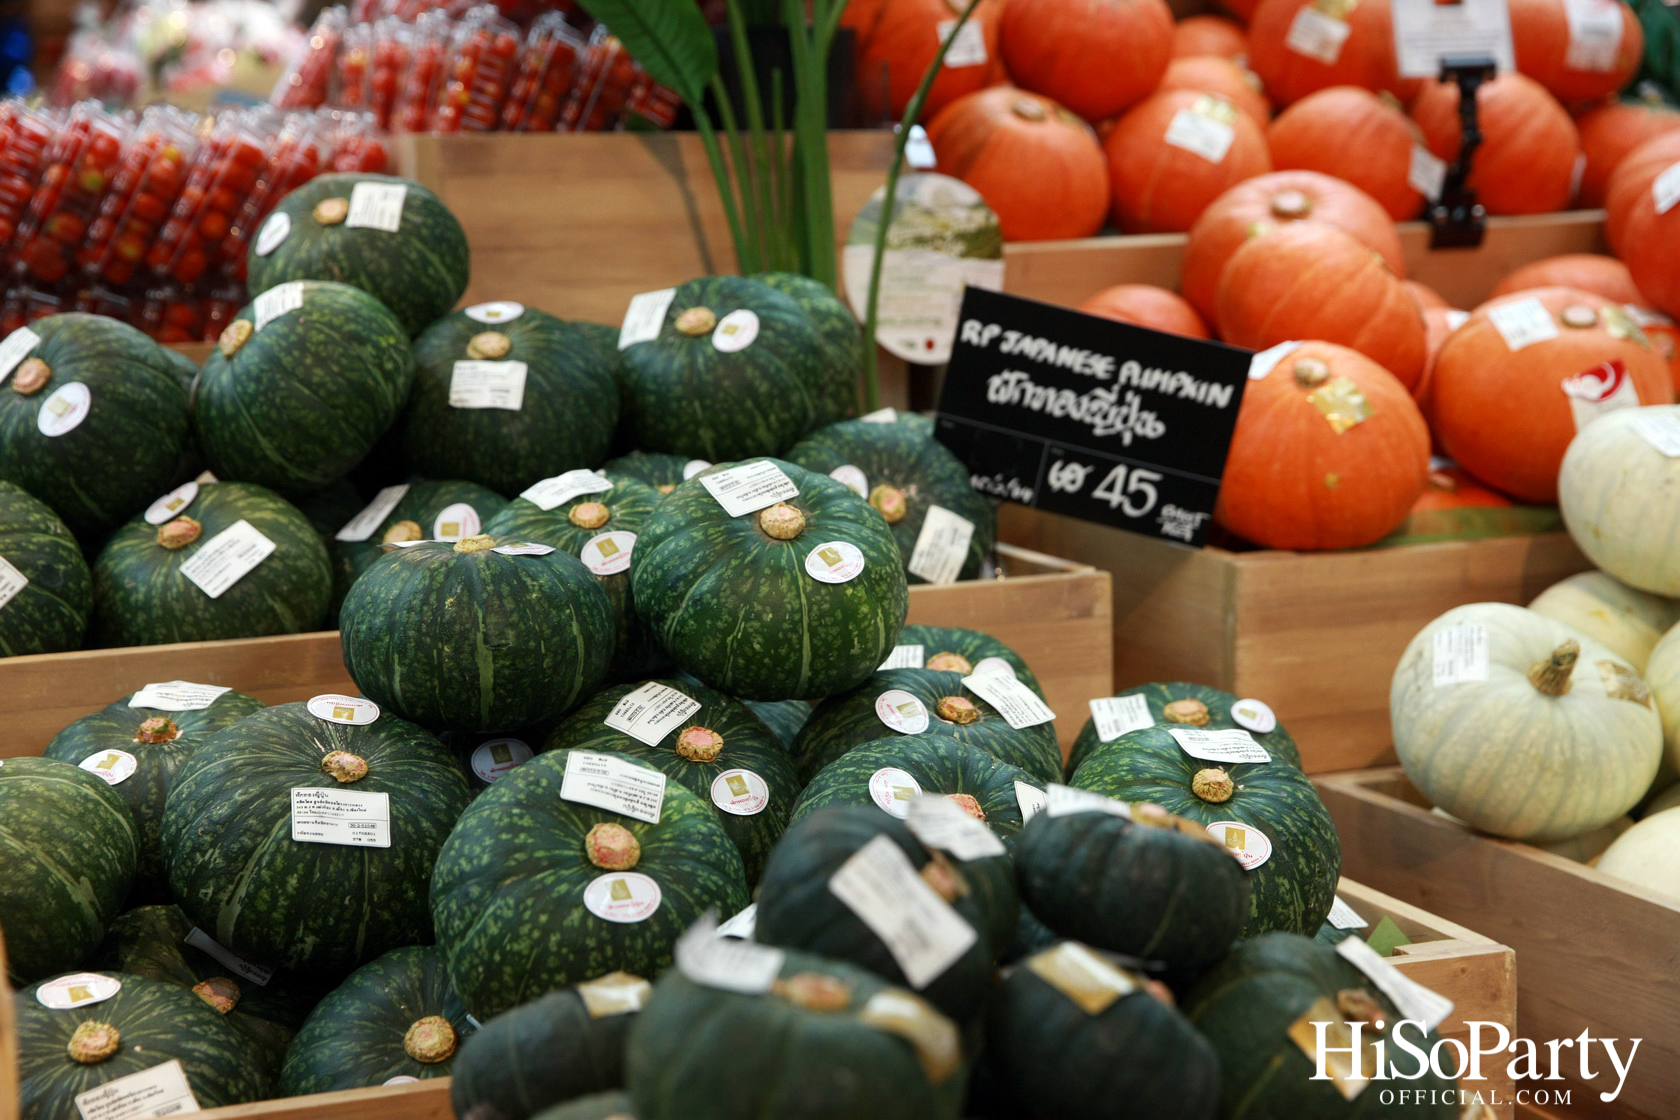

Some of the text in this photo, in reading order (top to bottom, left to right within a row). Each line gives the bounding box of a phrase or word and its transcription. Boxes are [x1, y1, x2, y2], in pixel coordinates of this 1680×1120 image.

[961, 319, 1000, 348] RP
[1000, 329, 1115, 380] JAPANESE
[1091, 463, 1164, 518] 45
